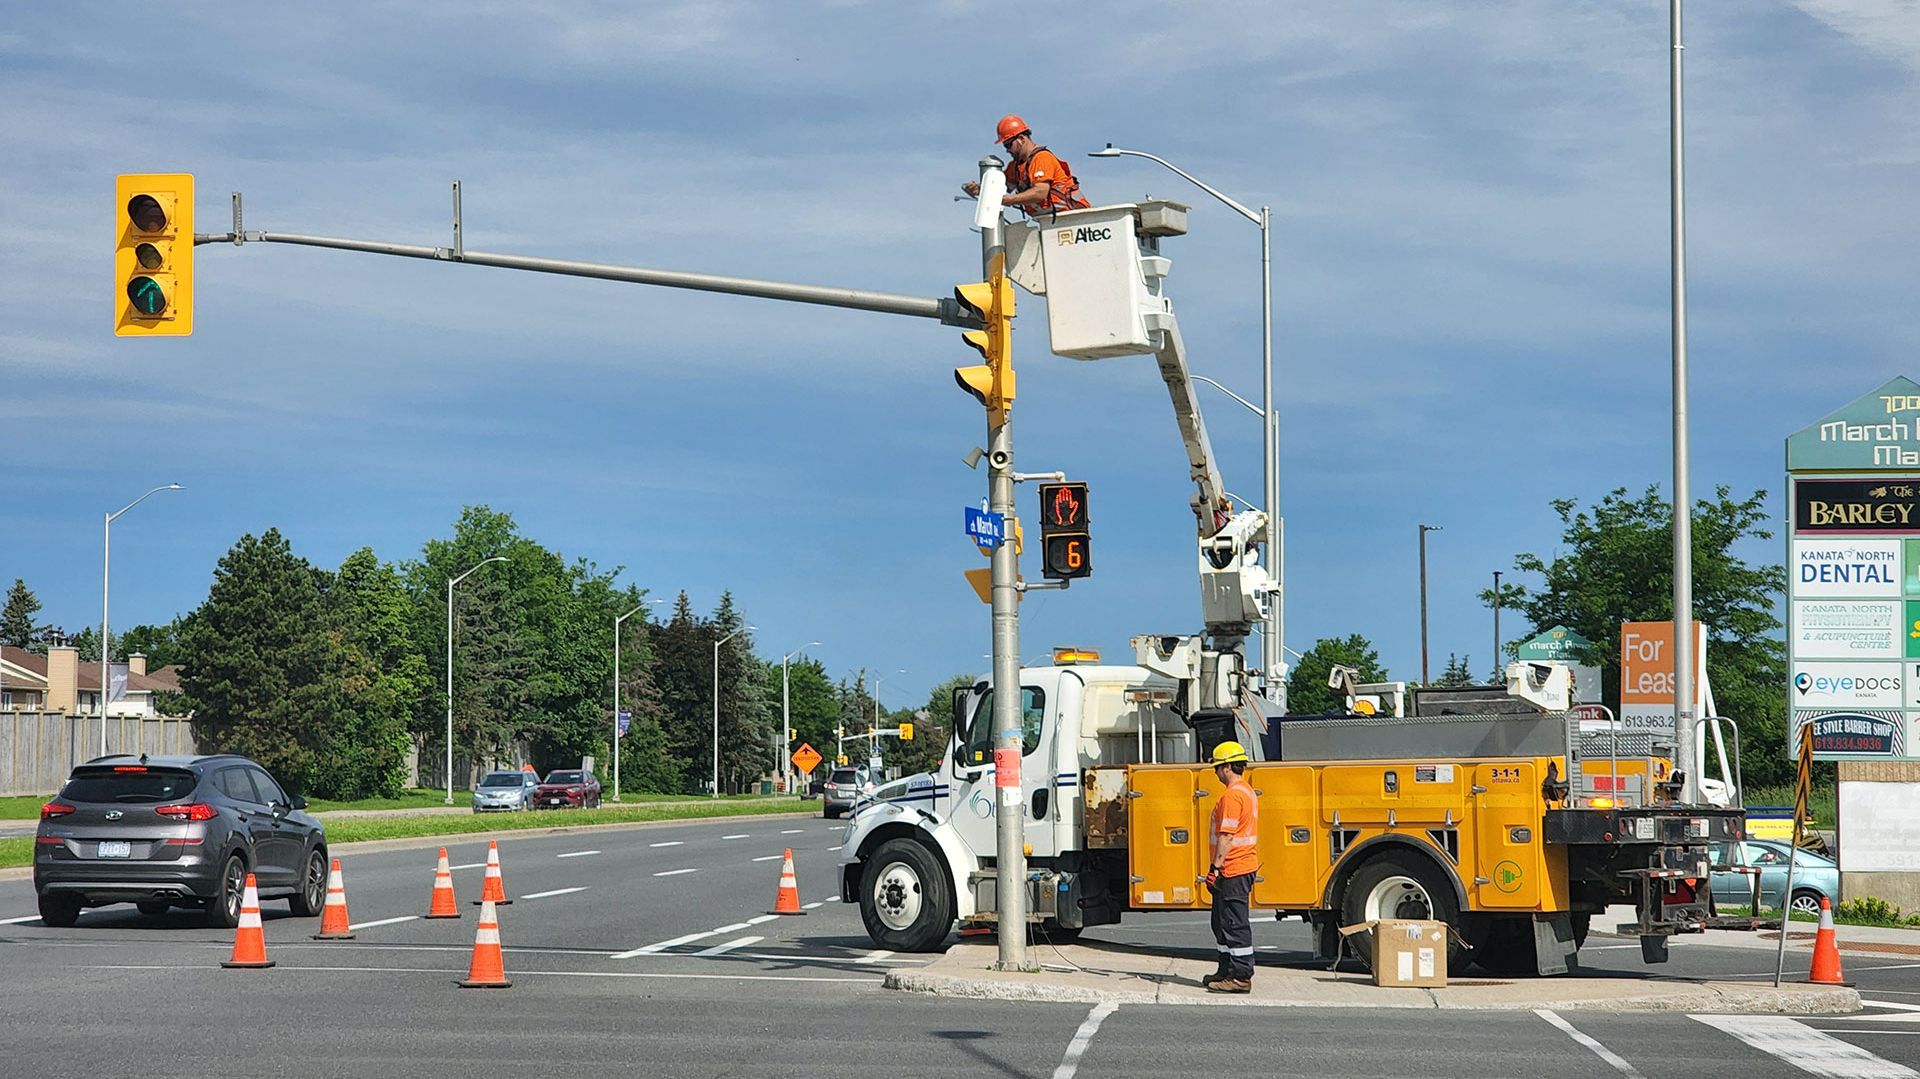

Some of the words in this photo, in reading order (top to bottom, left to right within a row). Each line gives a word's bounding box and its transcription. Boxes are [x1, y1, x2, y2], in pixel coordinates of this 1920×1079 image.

[1074, 227, 1112, 244] Altec
[1820, 416, 1909, 441] March
[1889, 485, 1914, 497] The
[1808, 500, 1915, 526] BARLEY
[1067, 541, 1081, 568] 6
[1800, 551, 1845, 561] KANATA
[1855, 551, 1895, 561] NORTH
[1801, 563, 1895, 584] DENTAL
[1802, 604, 1848, 613] KANATA
[1851, 604, 1893, 613] NORTH
[1625, 633, 1664, 662] For
[1849, 641, 1893, 649] CENTRE
[1625, 666, 1695, 694] Leas
[1625, 715, 1675, 728] 613.963.2
[1822, 720, 1844, 735] STYLE
[1844, 719, 1872, 736] BARBER
[1873, 722, 1893, 738] SHOP
[1491, 768, 1520, 778] 3-1-1
